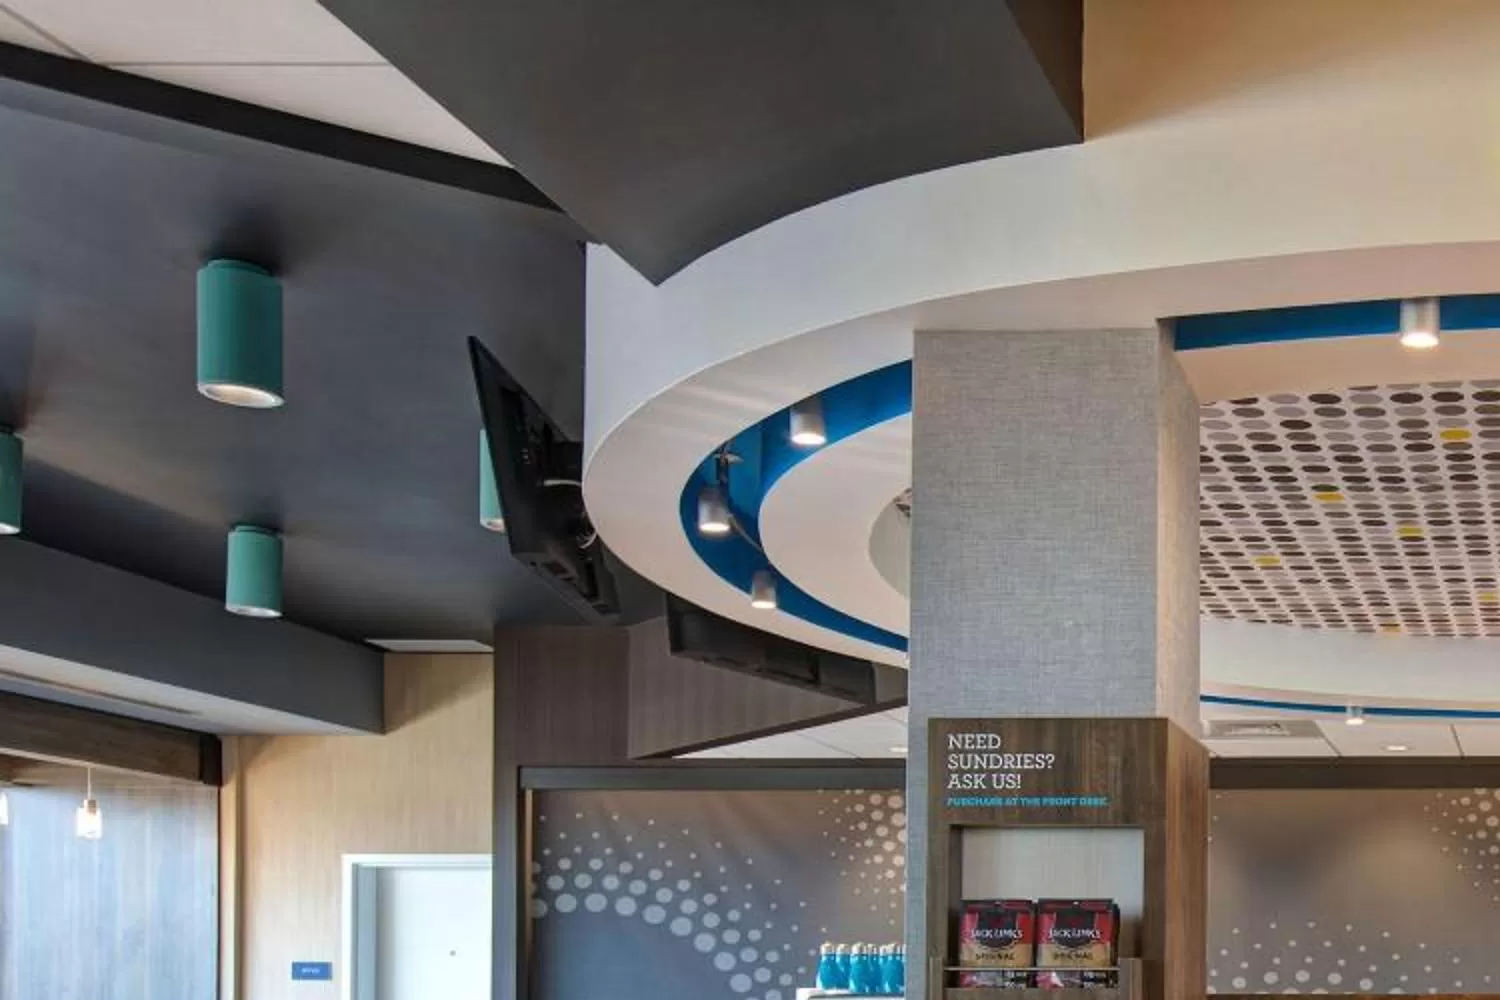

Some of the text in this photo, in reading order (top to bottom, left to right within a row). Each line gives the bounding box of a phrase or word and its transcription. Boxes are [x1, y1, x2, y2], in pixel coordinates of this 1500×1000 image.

[947, 733, 1001, 749] NEED
[947, 753, 1055, 769] SUNDRIES?
[947, 773, 1021, 789] ASK US!
